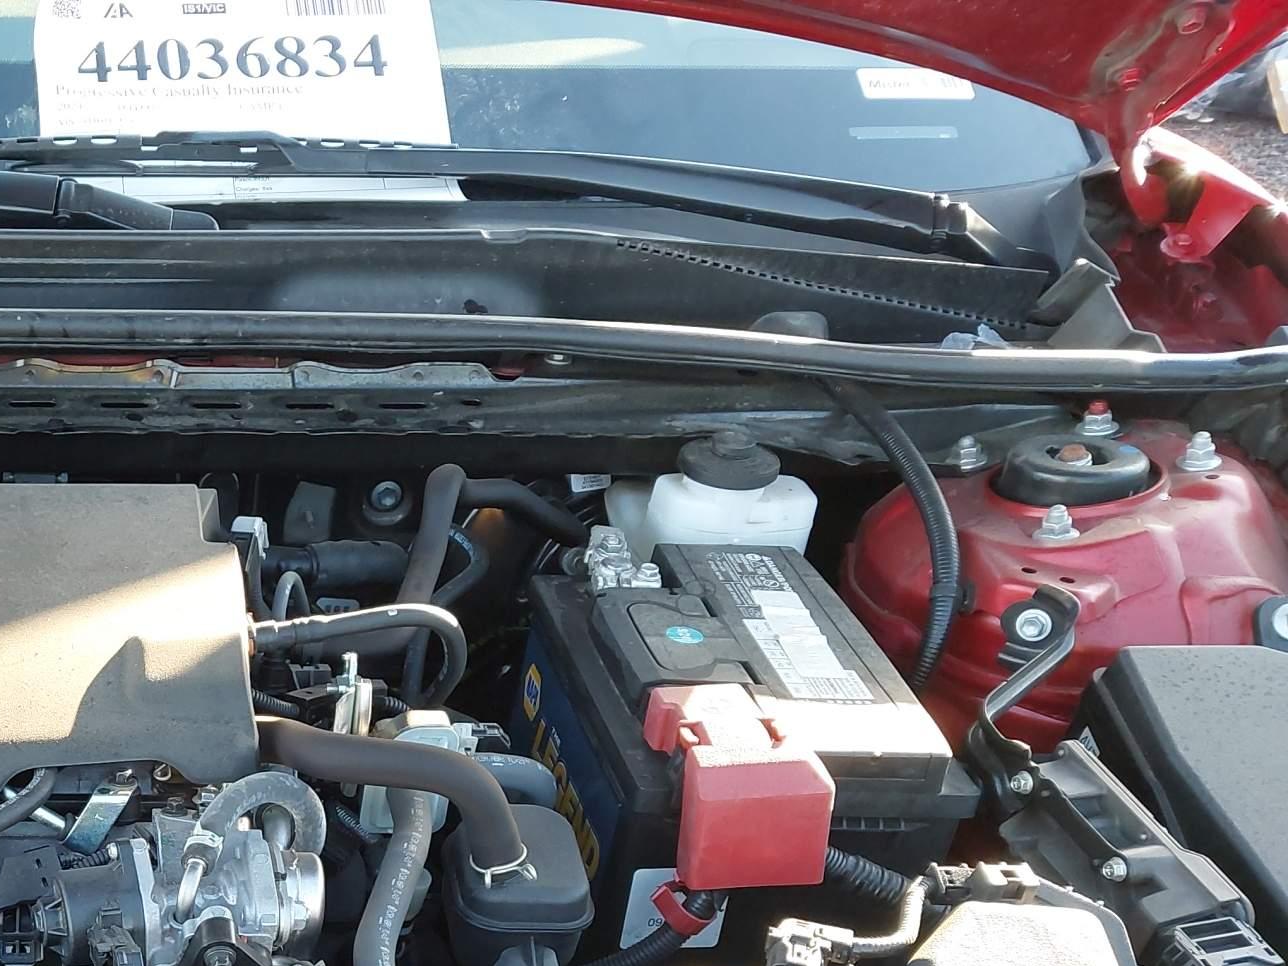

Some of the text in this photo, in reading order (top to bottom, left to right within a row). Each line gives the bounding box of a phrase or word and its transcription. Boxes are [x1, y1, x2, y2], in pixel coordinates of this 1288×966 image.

[78, 34, 388, 82] 44036834
[152, 83, 219, 99] Casualty
[227, 83, 304, 96] Insurance
